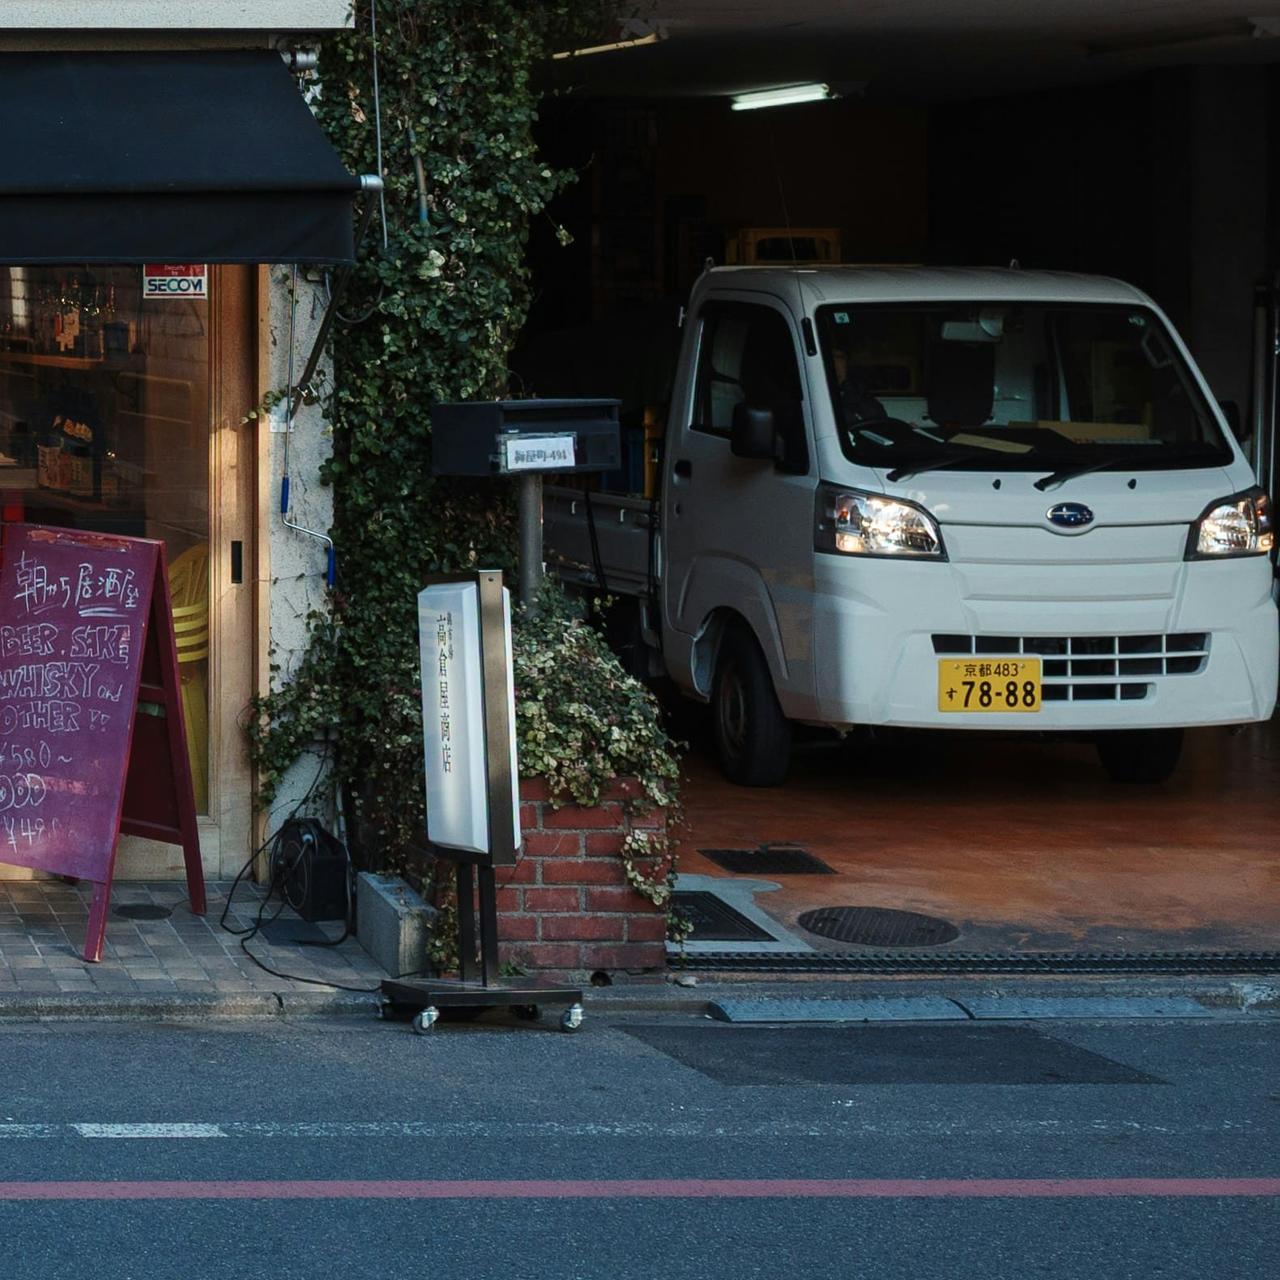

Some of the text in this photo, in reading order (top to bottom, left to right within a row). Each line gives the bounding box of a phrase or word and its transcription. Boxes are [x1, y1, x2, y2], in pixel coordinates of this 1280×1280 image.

[148, 279, 202, 292] SECOM
[97, 684, 123, 702] and
[436, 614, 452, 773] 高倉屋商店
[961, 681, 1036, 708] 78-88
[0, 699, 82, 735] OTHER
